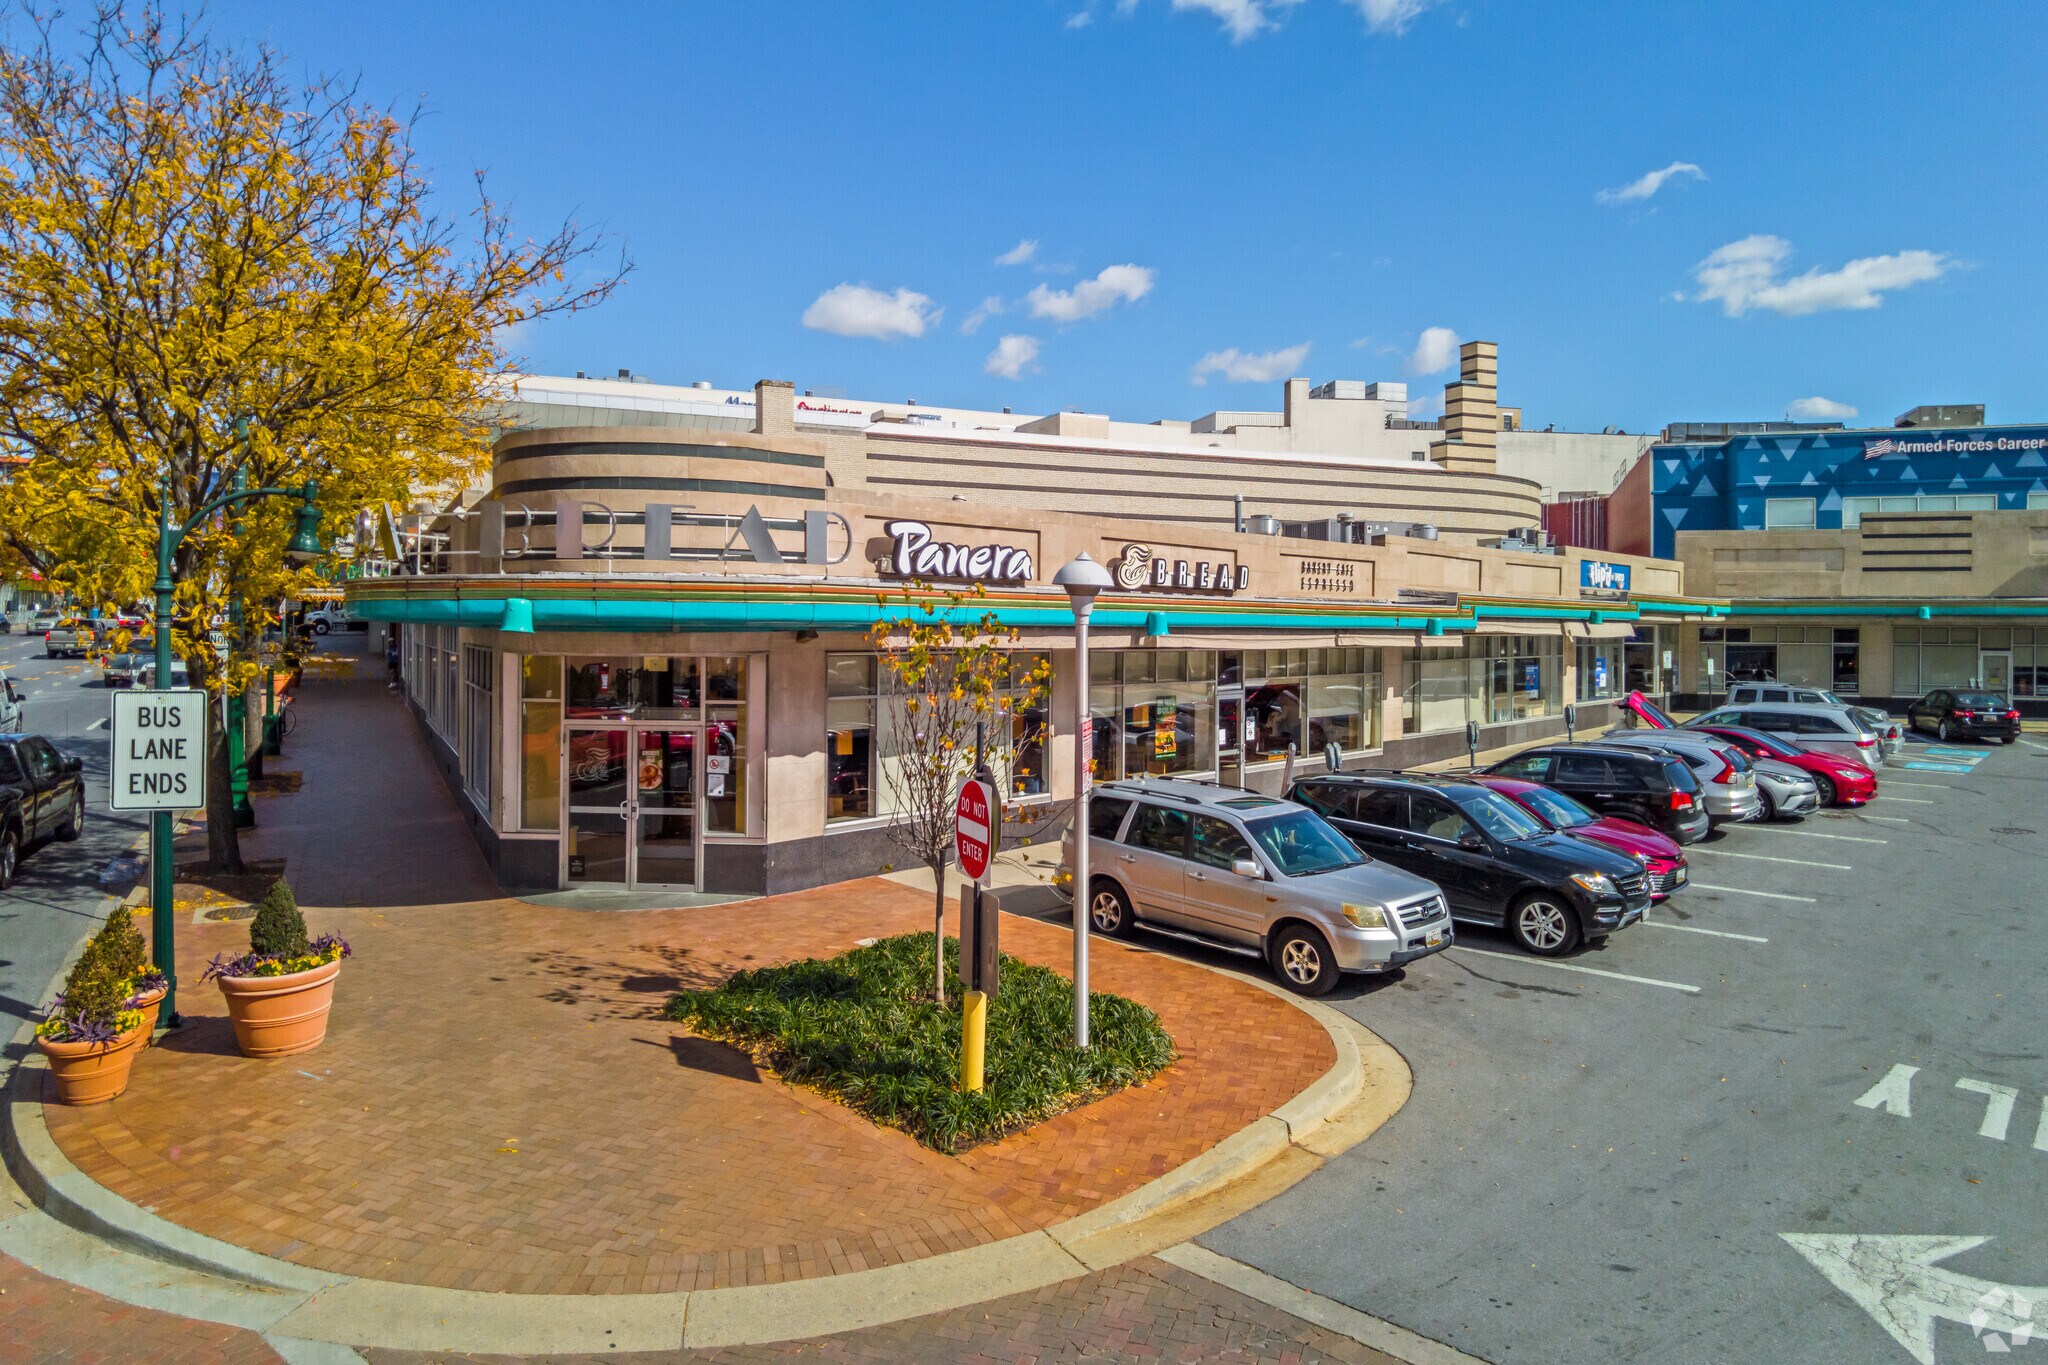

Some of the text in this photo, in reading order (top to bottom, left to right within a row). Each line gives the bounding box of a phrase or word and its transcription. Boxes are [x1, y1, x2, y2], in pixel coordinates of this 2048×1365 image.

[1897, 437, 2046, 453] Armed Forces Career
[479, 500, 853, 565] BREAD
[885, 520, 1033, 581] Panera
[1151, 558, 1249, 590] BREAD
[1301, 561, 1331, 575] BAKERY
[1301, 577, 1354, 593] ESPRESSO
[138, 706, 181, 728] BUS
[131, 738, 187, 759] LANE
[129, 772, 187, 794] ENDS
[961, 796, 986, 819] DO NOT
[962, 840, 983, 863] ENTER
[1854, 1063, 2048, 1152] LY
